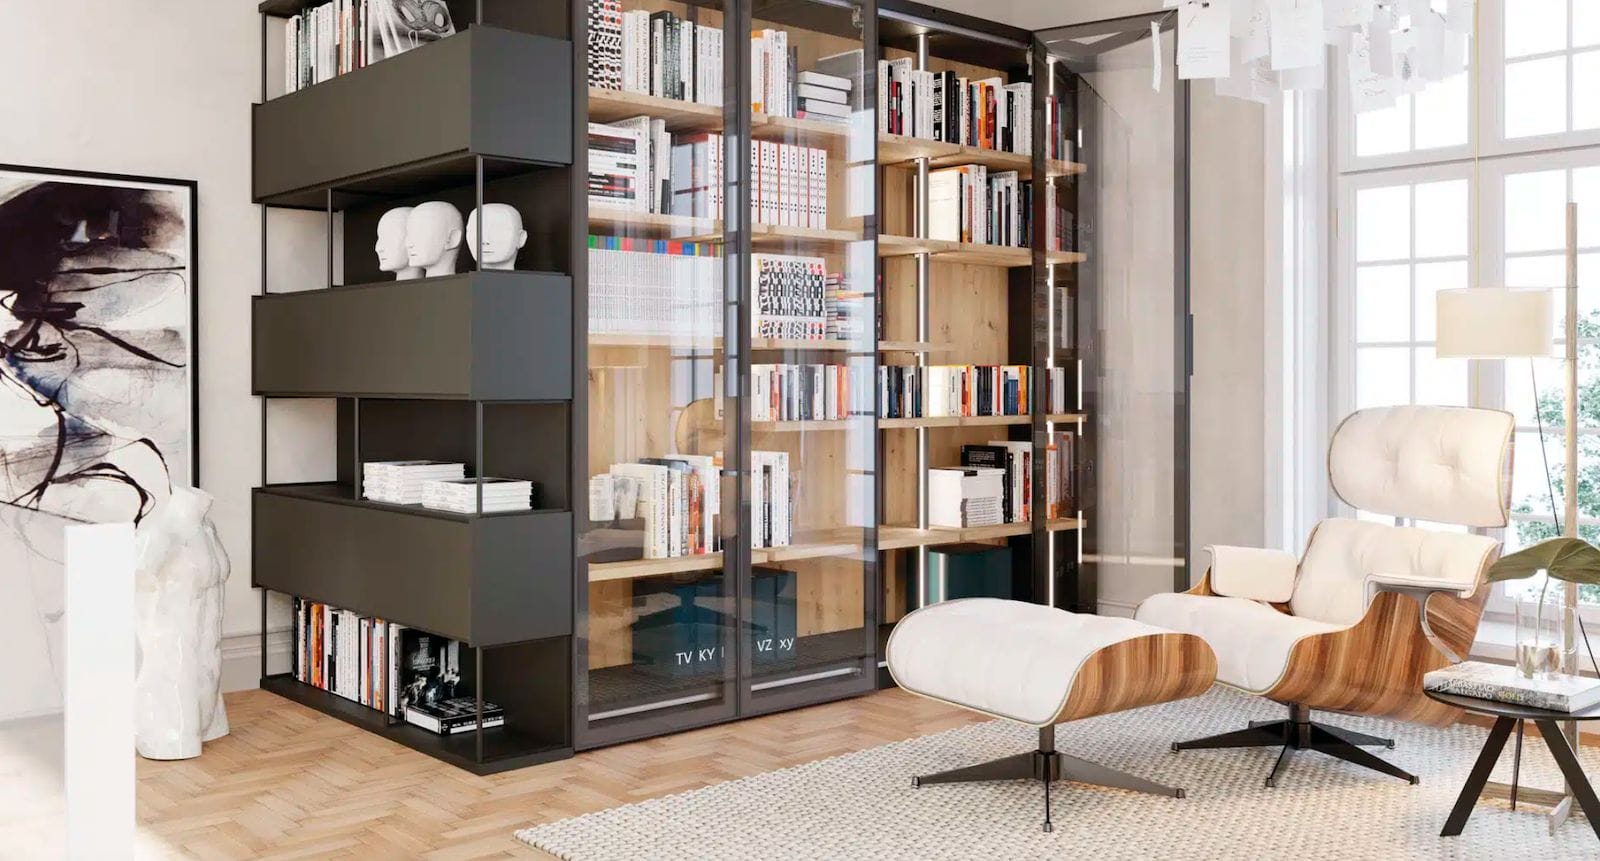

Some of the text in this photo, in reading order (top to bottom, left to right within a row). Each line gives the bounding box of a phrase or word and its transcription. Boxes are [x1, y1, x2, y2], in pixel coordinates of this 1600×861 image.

[675, 651, 693, 665] TV
[698, 647, 715, 662] KY
[757, 639, 773, 652] VZ
[779, 638, 794, 651] xy
